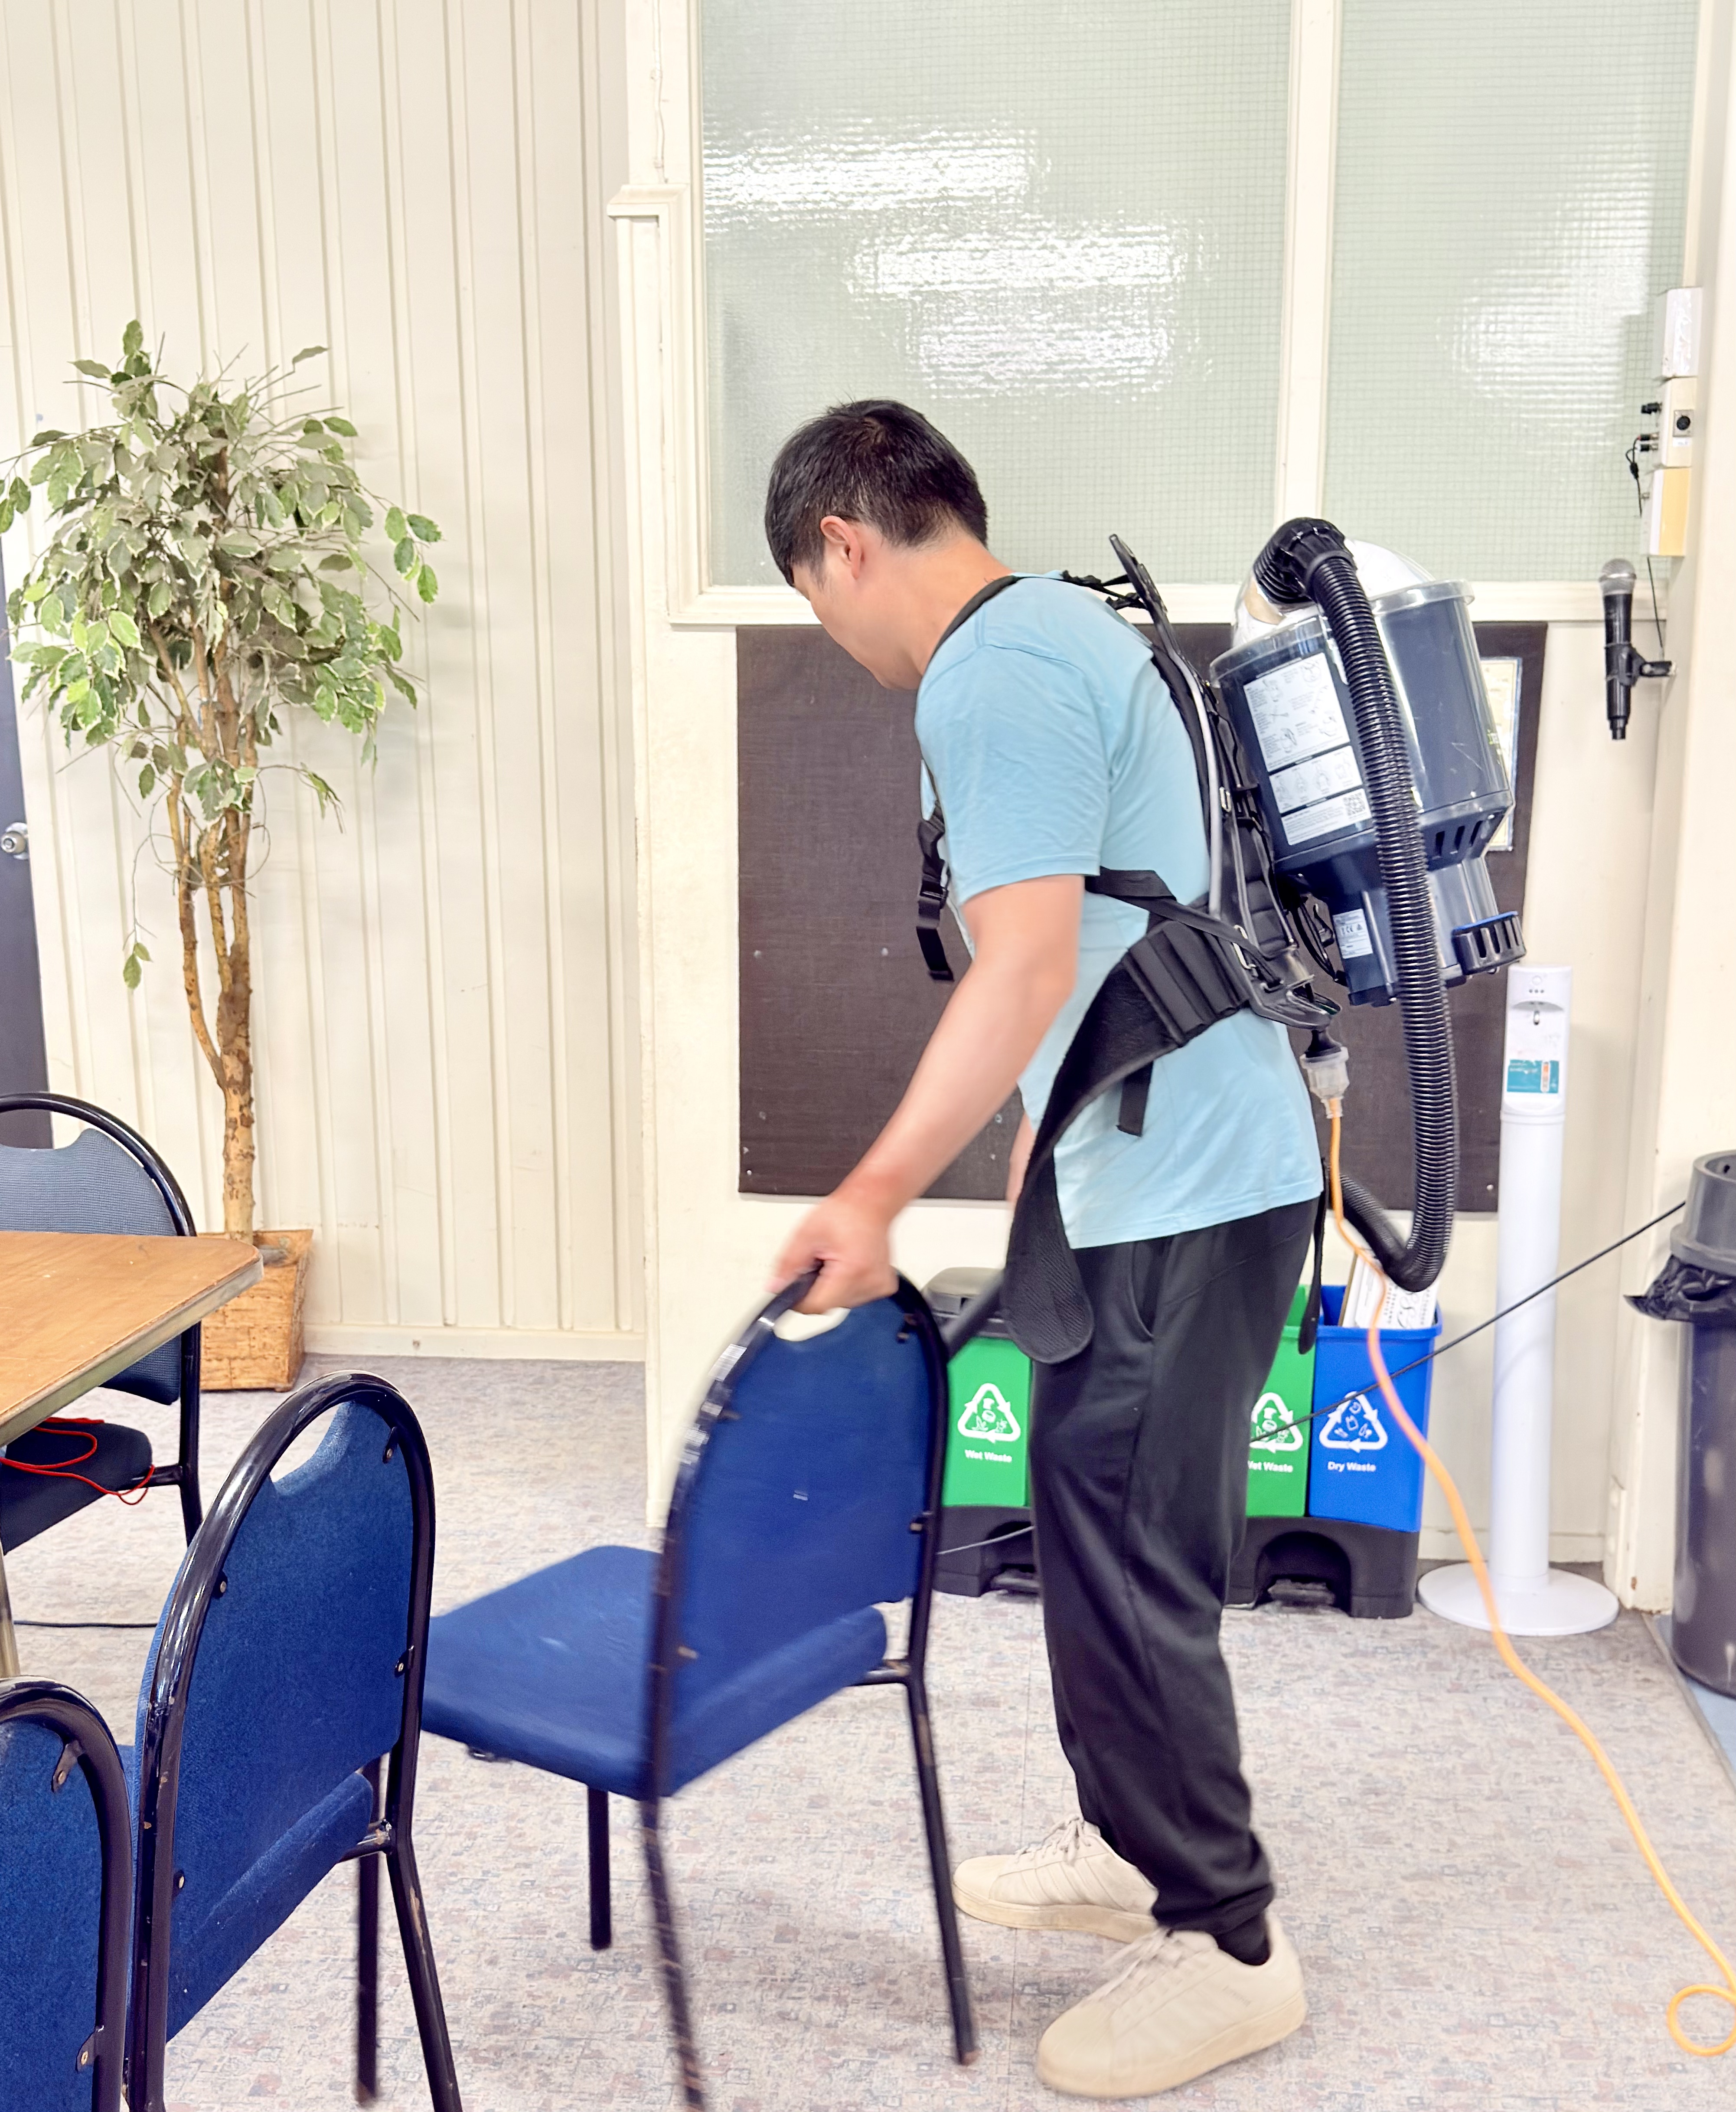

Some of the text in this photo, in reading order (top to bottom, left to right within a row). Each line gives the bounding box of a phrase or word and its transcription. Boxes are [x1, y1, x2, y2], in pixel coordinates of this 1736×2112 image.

[965, 1449, 1012, 1462] Wet Waste
[1263, 1461, 1293, 1473] Waste
[1328, 1461, 1376, 1473] Dry Waste
